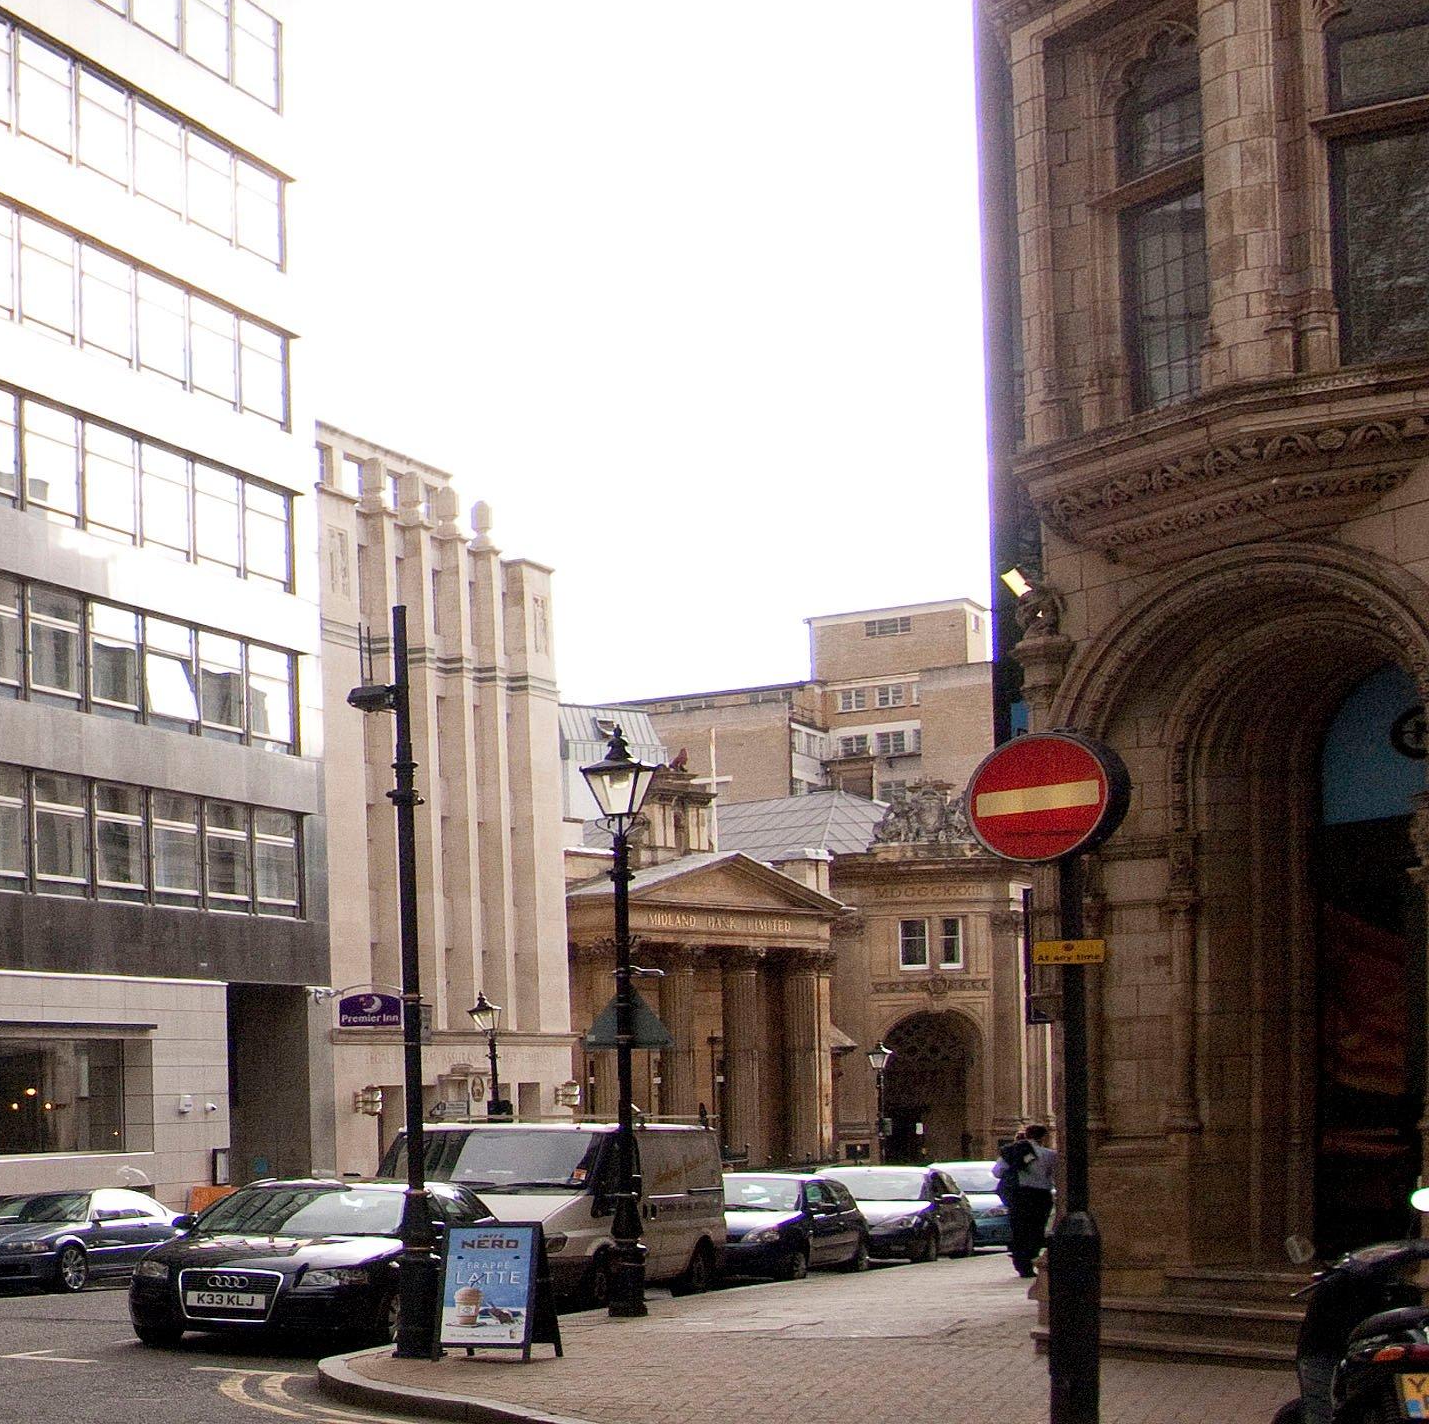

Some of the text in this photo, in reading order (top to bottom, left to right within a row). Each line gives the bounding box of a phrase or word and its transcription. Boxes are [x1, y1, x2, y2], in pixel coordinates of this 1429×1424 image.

[647, 913, 791, 932] MIDLAND BANK LIMITED
[341, 1013, 399, 1024] Premier Inn
[461, 1239, 519, 1250] NERO
[456, 1271, 522, 1285] LATTE
[196, 1293, 255, 1307] K33 KLJ
